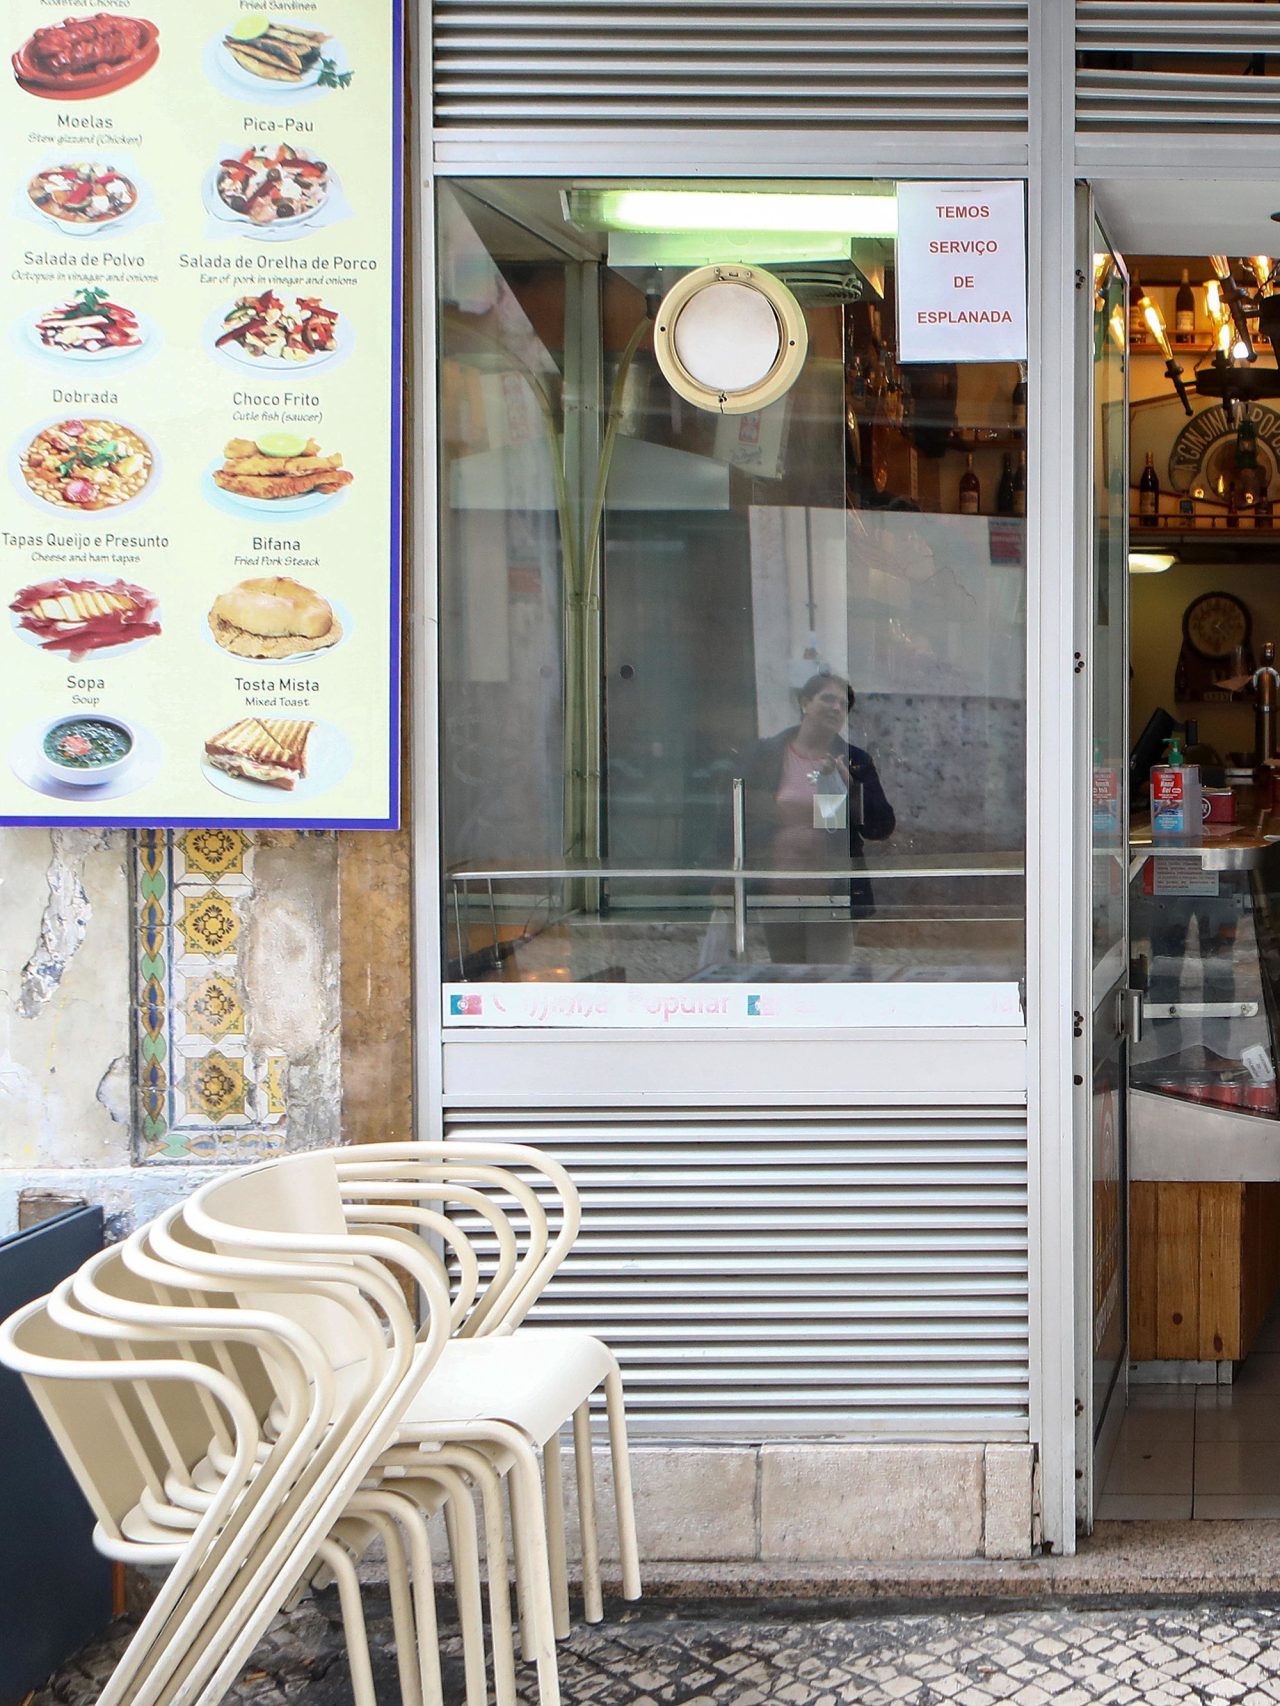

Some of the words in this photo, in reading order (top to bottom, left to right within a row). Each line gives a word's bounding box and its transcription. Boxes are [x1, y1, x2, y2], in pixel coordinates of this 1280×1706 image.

[57, 114, 114, 129] Moelas
[243, 117, 314, 132] Pica-Pau
[936, 205, 990, 218] TEMOS
[929, 240, 998, 256] SERVIÇO
[24, 251, 77, 266] Salada
[81, 252, 99, 266] de
[103, 252, 145, 267] Polvo
[179, 254, 231, 268] Salada
[235, 255, 252, 268] de
[257, 255, 308, 269] Orelha
[311, 256, 329, 269] de
[333, 256, 377, 270] Porco
[953, 276, 975, 288] DE
[917, 310, 1013, 324] ESPLANADA
[52, 389, 118, 405] Dobrada
[233, 391, 280, 406] Choco
[284, 392, 320, 407] Frito
[2, 532, 43, 549] Tapas
[46, 533, 91, 550] Queijo
[94, 537, 102, 547] e
[105, 533, 169, 548] Presunto
[252, 536, 301, 551] Bifana
[69, 553, 87, 562] and
[89, 552, 110, 562] ham
[234, 556, 259, 566] Fried
[67, 675, 105, 691] Sopa
[235, 677, 275, 692] Tosta
[279, 678, 320, 692] Mista
[245, 697, 276, 707] Mixed
[279, 697, 310, 708] Toast
